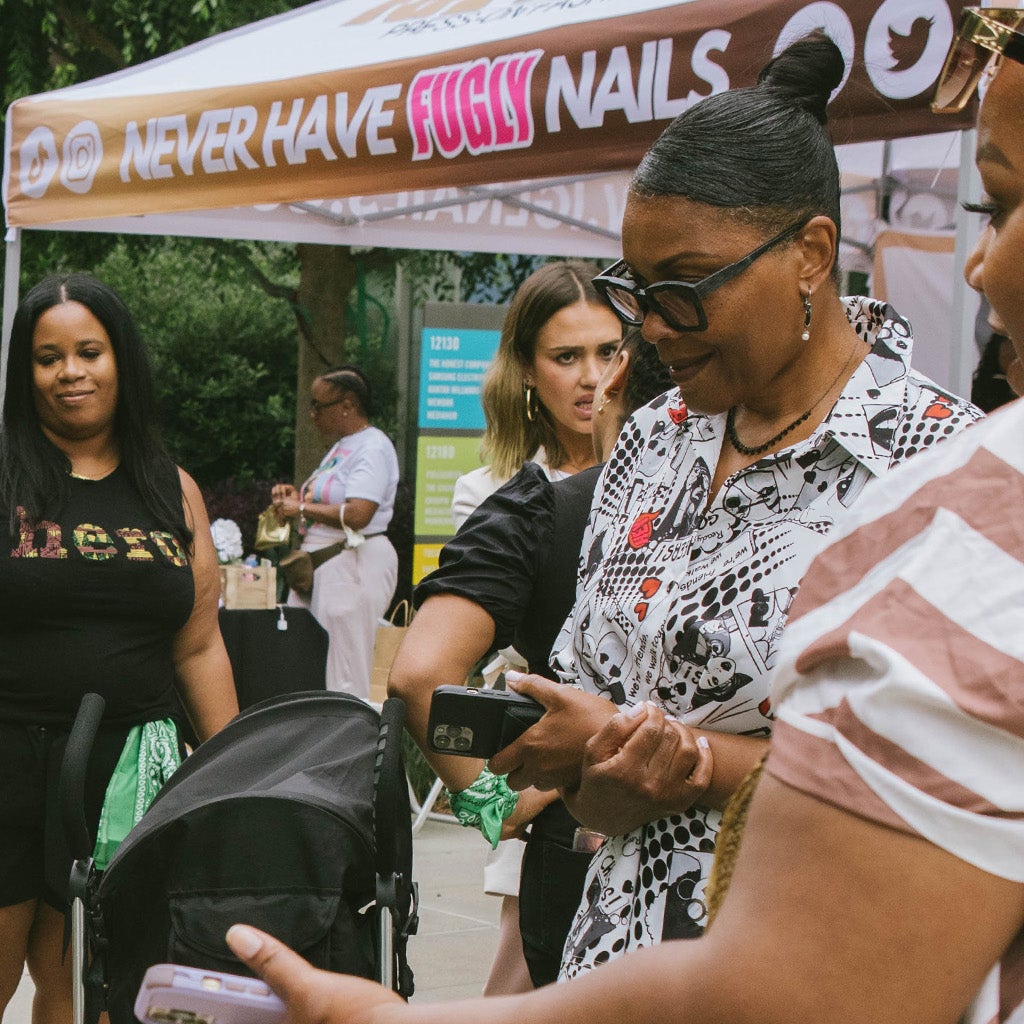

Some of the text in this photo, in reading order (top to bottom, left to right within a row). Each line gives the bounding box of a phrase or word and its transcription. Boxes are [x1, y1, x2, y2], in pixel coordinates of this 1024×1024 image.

[120, 29, 732, 183] NEVER HAVE FUGLY NAILS
[430, 336, 460, 351] 12130
[10, 505, 189, 567] hero
